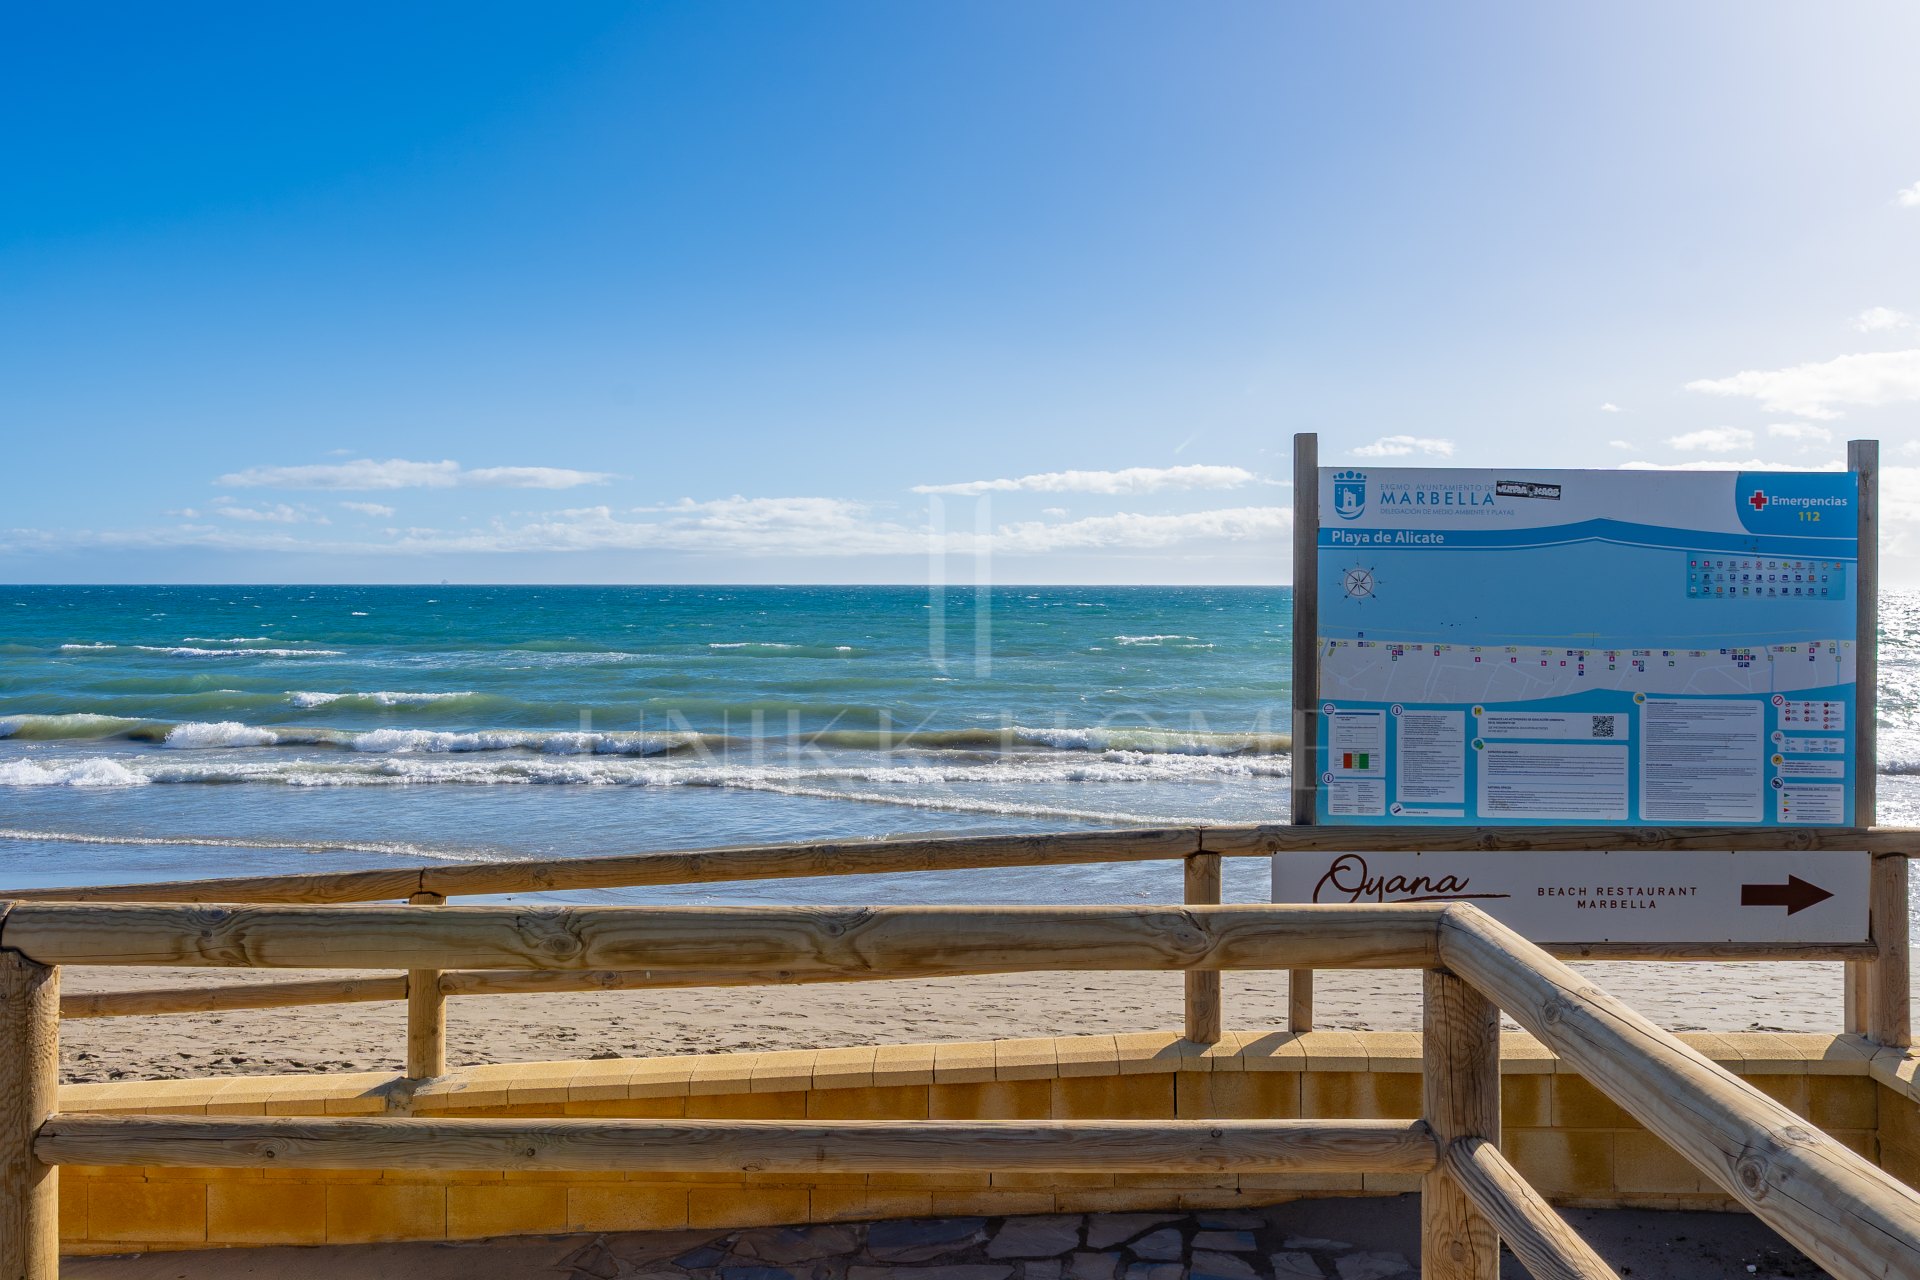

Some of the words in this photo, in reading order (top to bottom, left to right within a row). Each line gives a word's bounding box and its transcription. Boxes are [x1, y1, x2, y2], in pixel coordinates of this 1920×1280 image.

[1416, 483, 1482, 491] AYUNTAMIENTO
[1380, 491, 1495, 506] MARBELLA
[1771, 495, 1848, 508] Emergencias
[1798, 511, 1821, 522] 112
[1332, 530, 1370, 546] Playa
[1373, 530, 1391, 543] de
[1395, 531, 1444, 544] Alicate
[1313, 853, 1510, 903] Oyana
[1537, 886, 1588, 896] BEACH
[1596, 886, 1698, 896] RESTAURANT
[1576, 899, 1658, 909] MARBELLA
